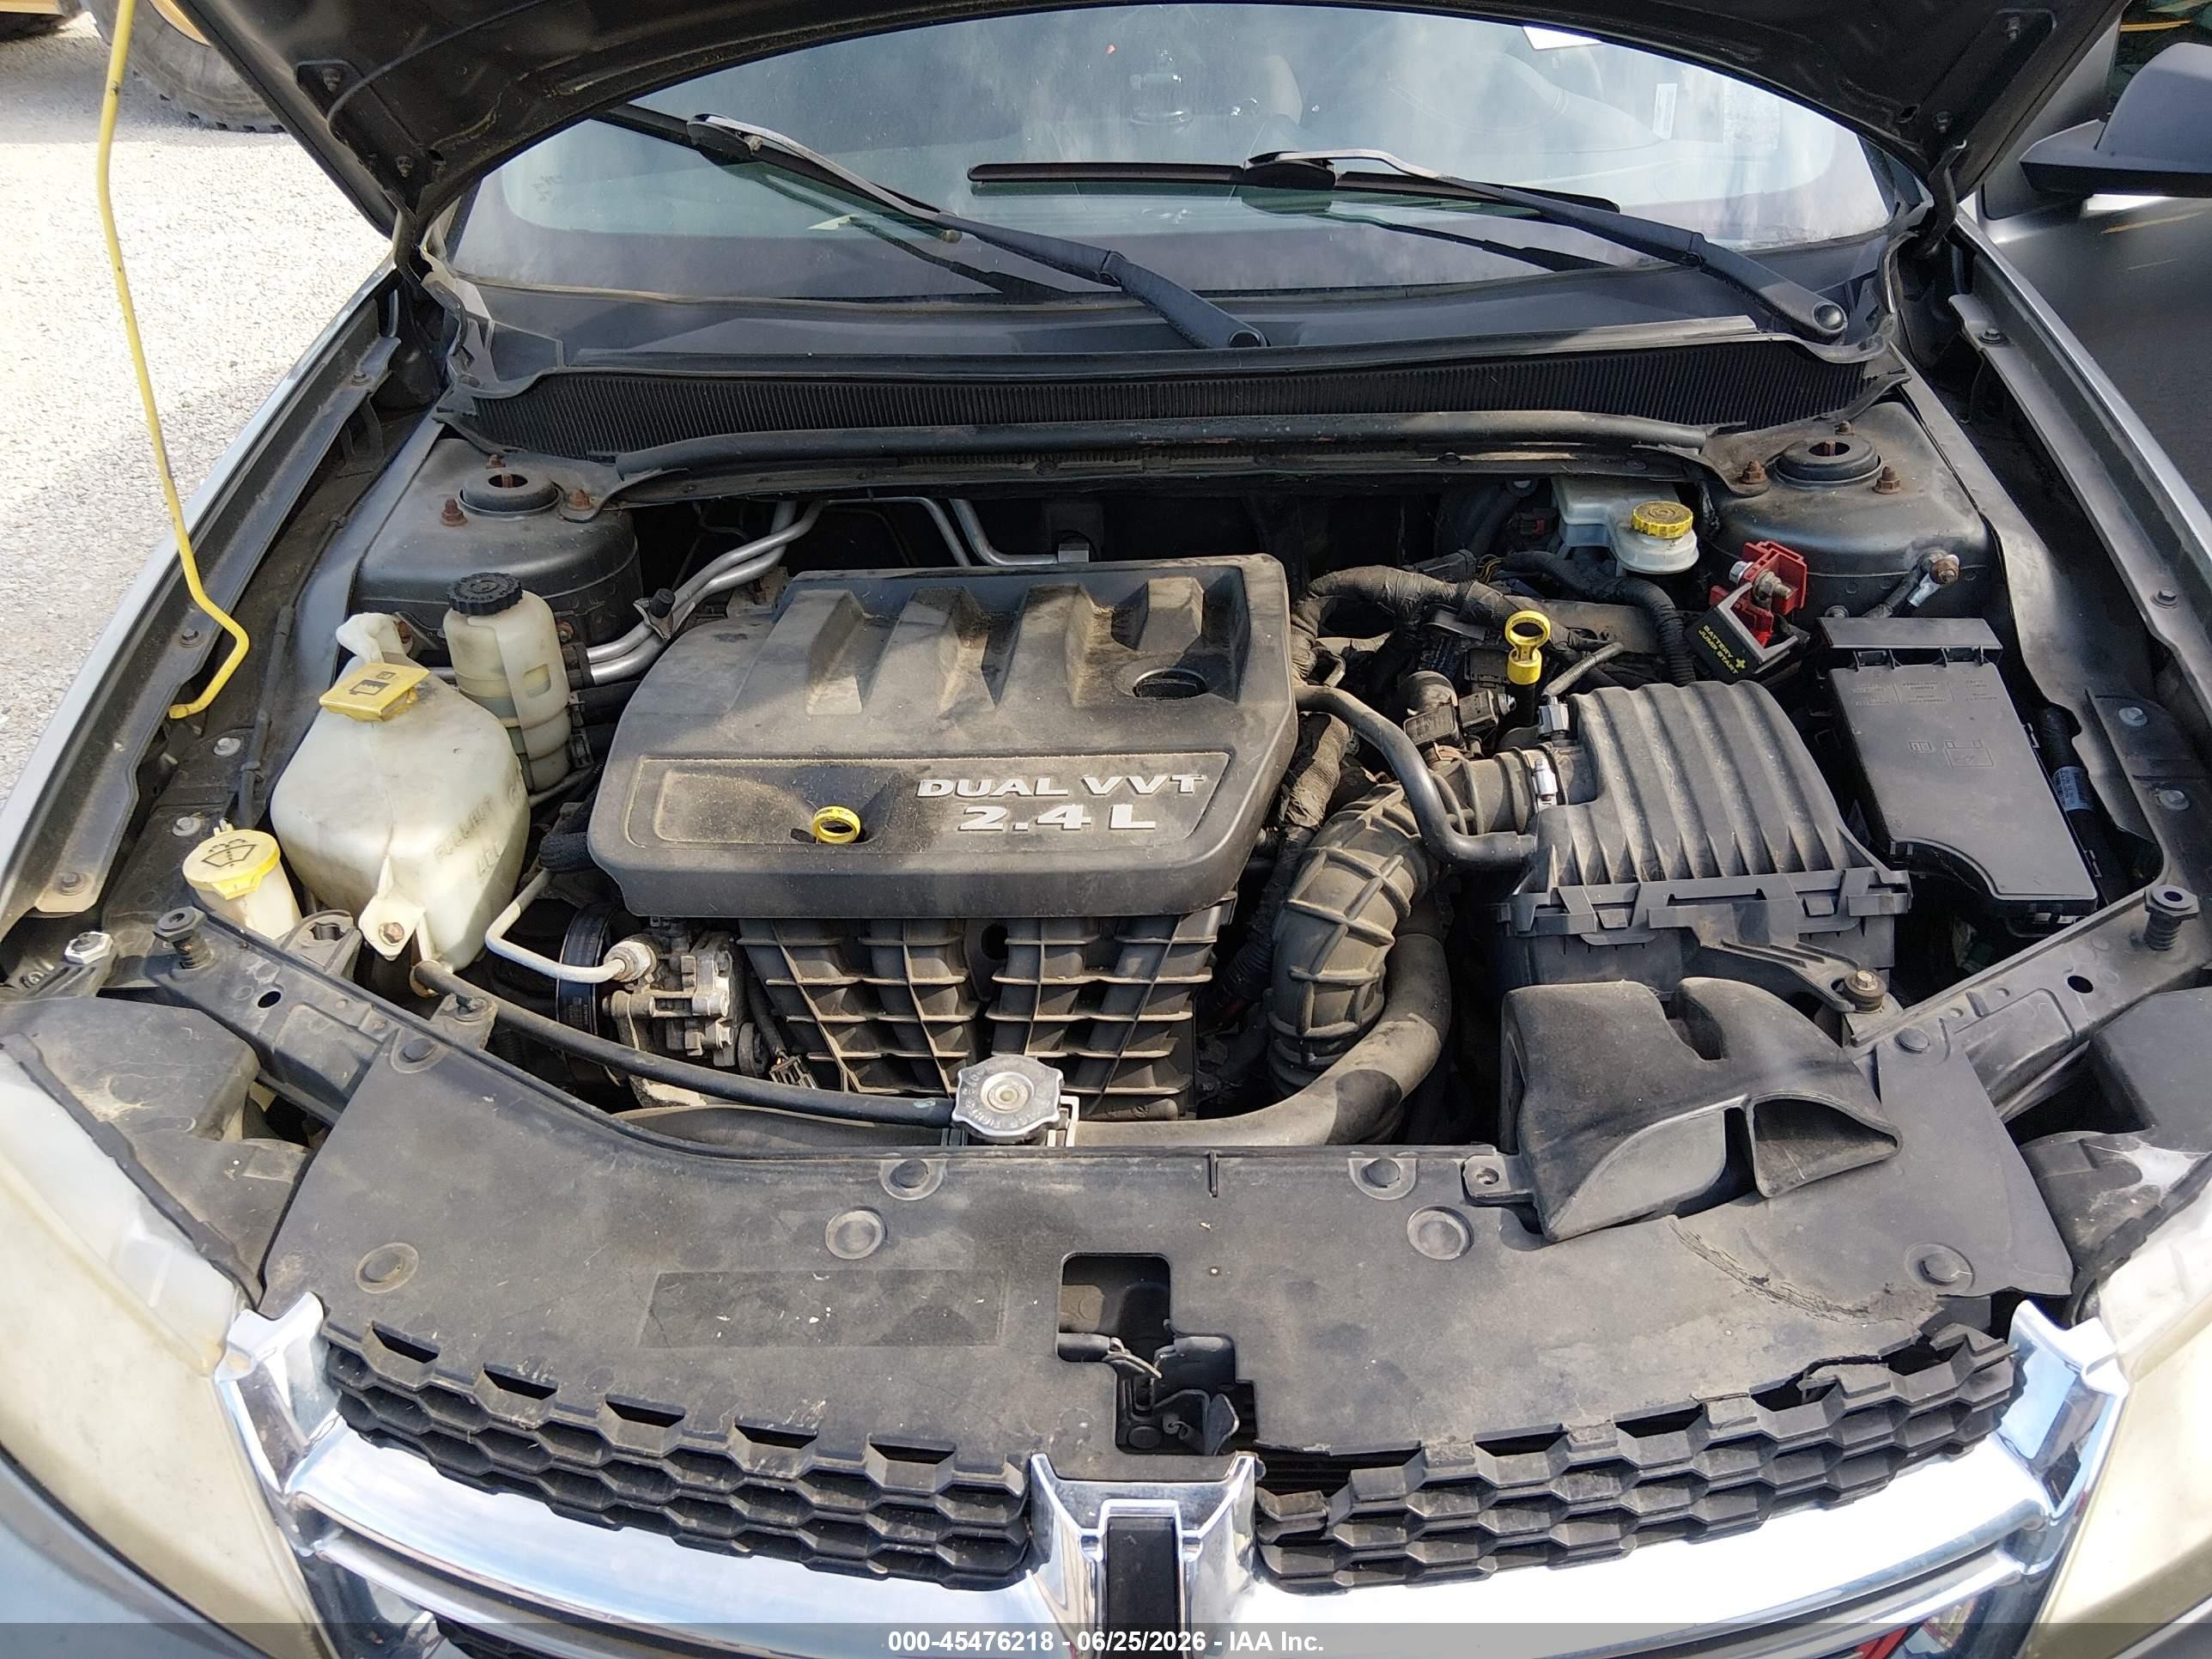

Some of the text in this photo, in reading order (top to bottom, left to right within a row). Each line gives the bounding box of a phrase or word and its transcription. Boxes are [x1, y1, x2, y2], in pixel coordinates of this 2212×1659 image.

[1698, 629, 1739, 674] JUMP START
[1703, 624, 1734, 658] BATTERY
[916, 774, 1205, 797] DUAL VVT
